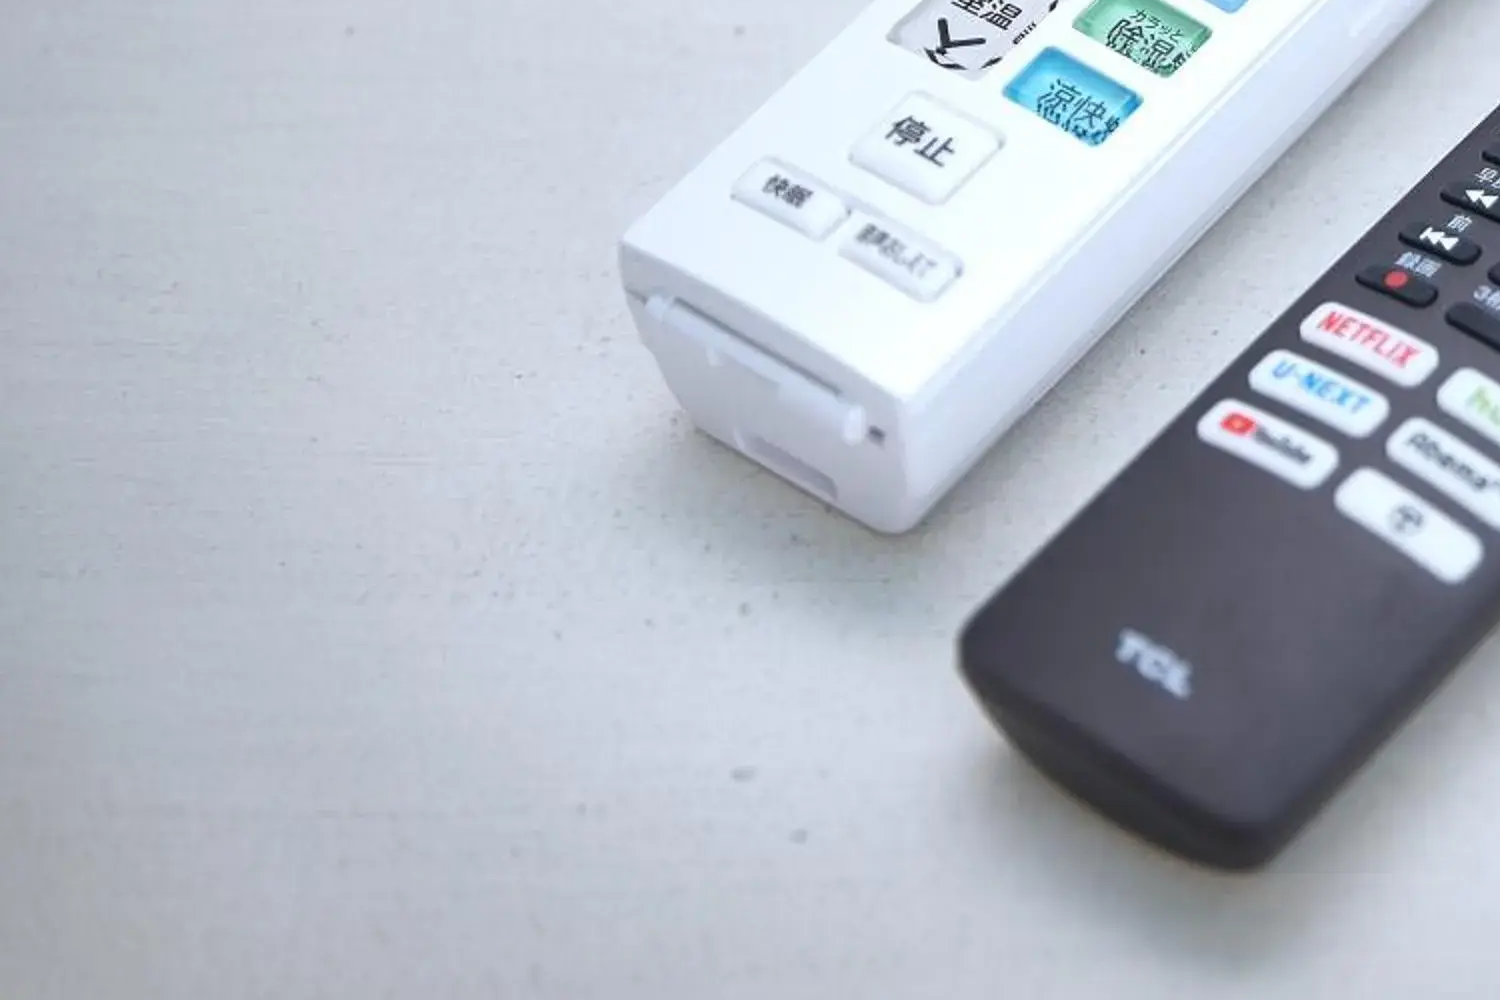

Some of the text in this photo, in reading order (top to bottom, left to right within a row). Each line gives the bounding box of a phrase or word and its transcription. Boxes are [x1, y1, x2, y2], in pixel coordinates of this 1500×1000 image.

[1107, 19, 1180, 69] 除湿
[1130, 8, 1184, 38] カラッと
[884, 115, 955, 167] 停止
[1447, 214, 1473, 233] 前
[1316, 311, 1423, 369] NETFLIX
[1271, 359, 1372, 414] U-NEXT
[1115, 626, 1193, 700] TCL
